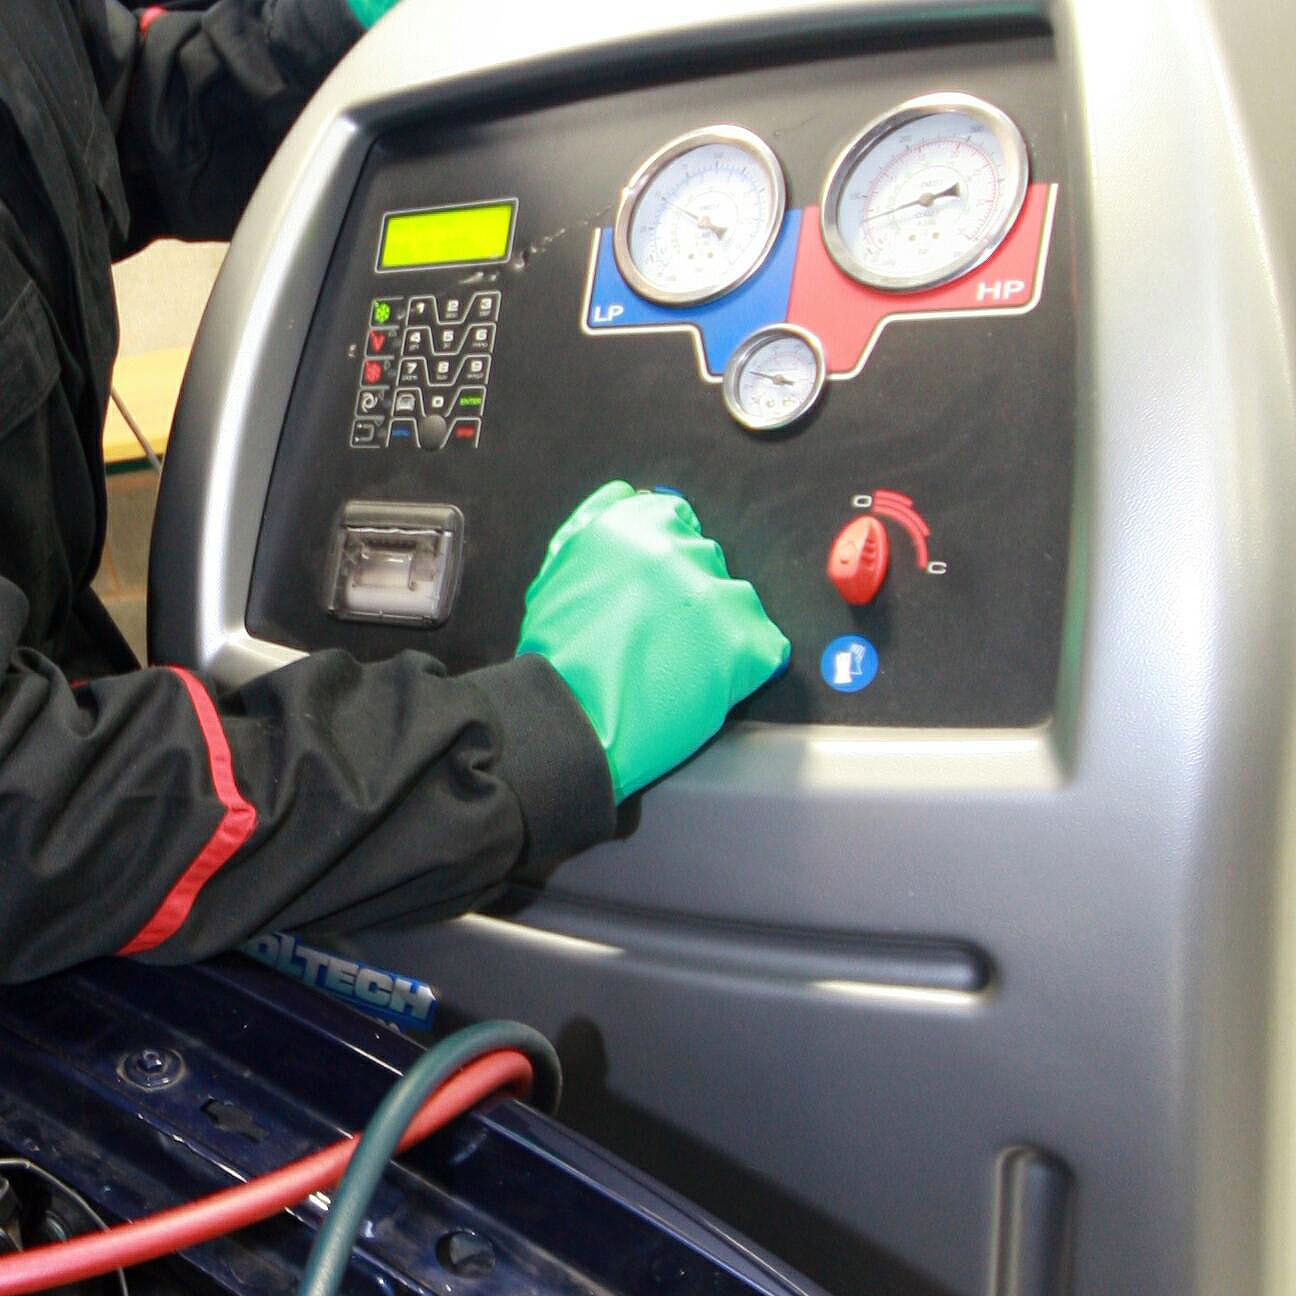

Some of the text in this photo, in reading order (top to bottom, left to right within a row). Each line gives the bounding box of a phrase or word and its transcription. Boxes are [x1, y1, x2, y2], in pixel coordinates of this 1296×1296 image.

[976, 280, 1025, 302] HP
[415, 298, 492, 314] 1 2 3
[594, 305, 624, 322] LP
[410, 329, 487, 343] 4 5 6
[406, 360, 482, 374] 7 8 9
[928, 561, 947, 575] C
